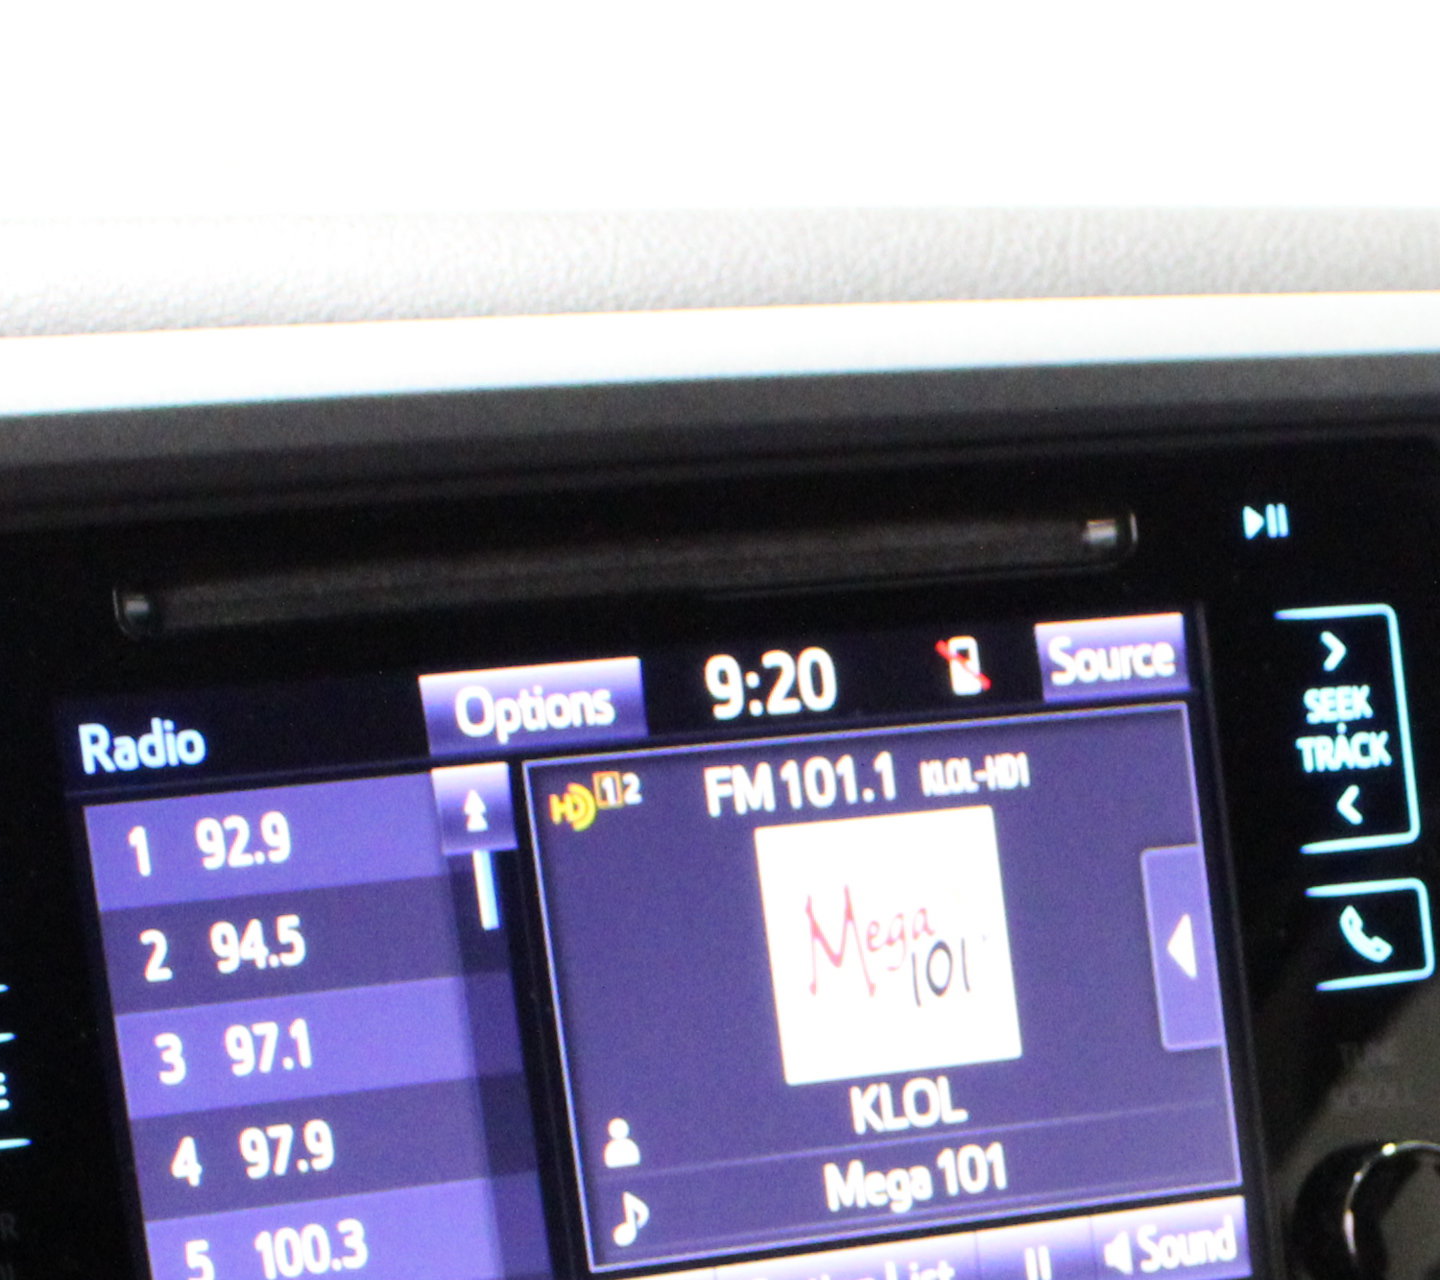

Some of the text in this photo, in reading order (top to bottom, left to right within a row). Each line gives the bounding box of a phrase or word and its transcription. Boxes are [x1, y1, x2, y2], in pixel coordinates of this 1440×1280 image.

[704, 646, 838, 721] 9:20
[1046, 636, 1177, 686] Source
[455, 684, 616, 745] Options
[1303, 685, 1374, 726] SEEK
[78, 717, 206, 774] Radio
[920, 752, 1031, 798] KLOL-HD1
[1295, 730, 1393, 774] TRACK
[127, 810, 292, 877] 1 92.9
[140, 914, 308, 983] 2 94.5
[910, 936, 973, 1008] 101
[154, 1018, 313, 1086] 3 97.1
[849, 1076, 969, 1135] KLOL
[170, 1119, 335, 1188] 4 97.9
[823, 1142, 1009, 1214] Mega 101
[254, 1218, 369, 1280] 100.3
[1138, 1213, 1238, 1275] Sound
